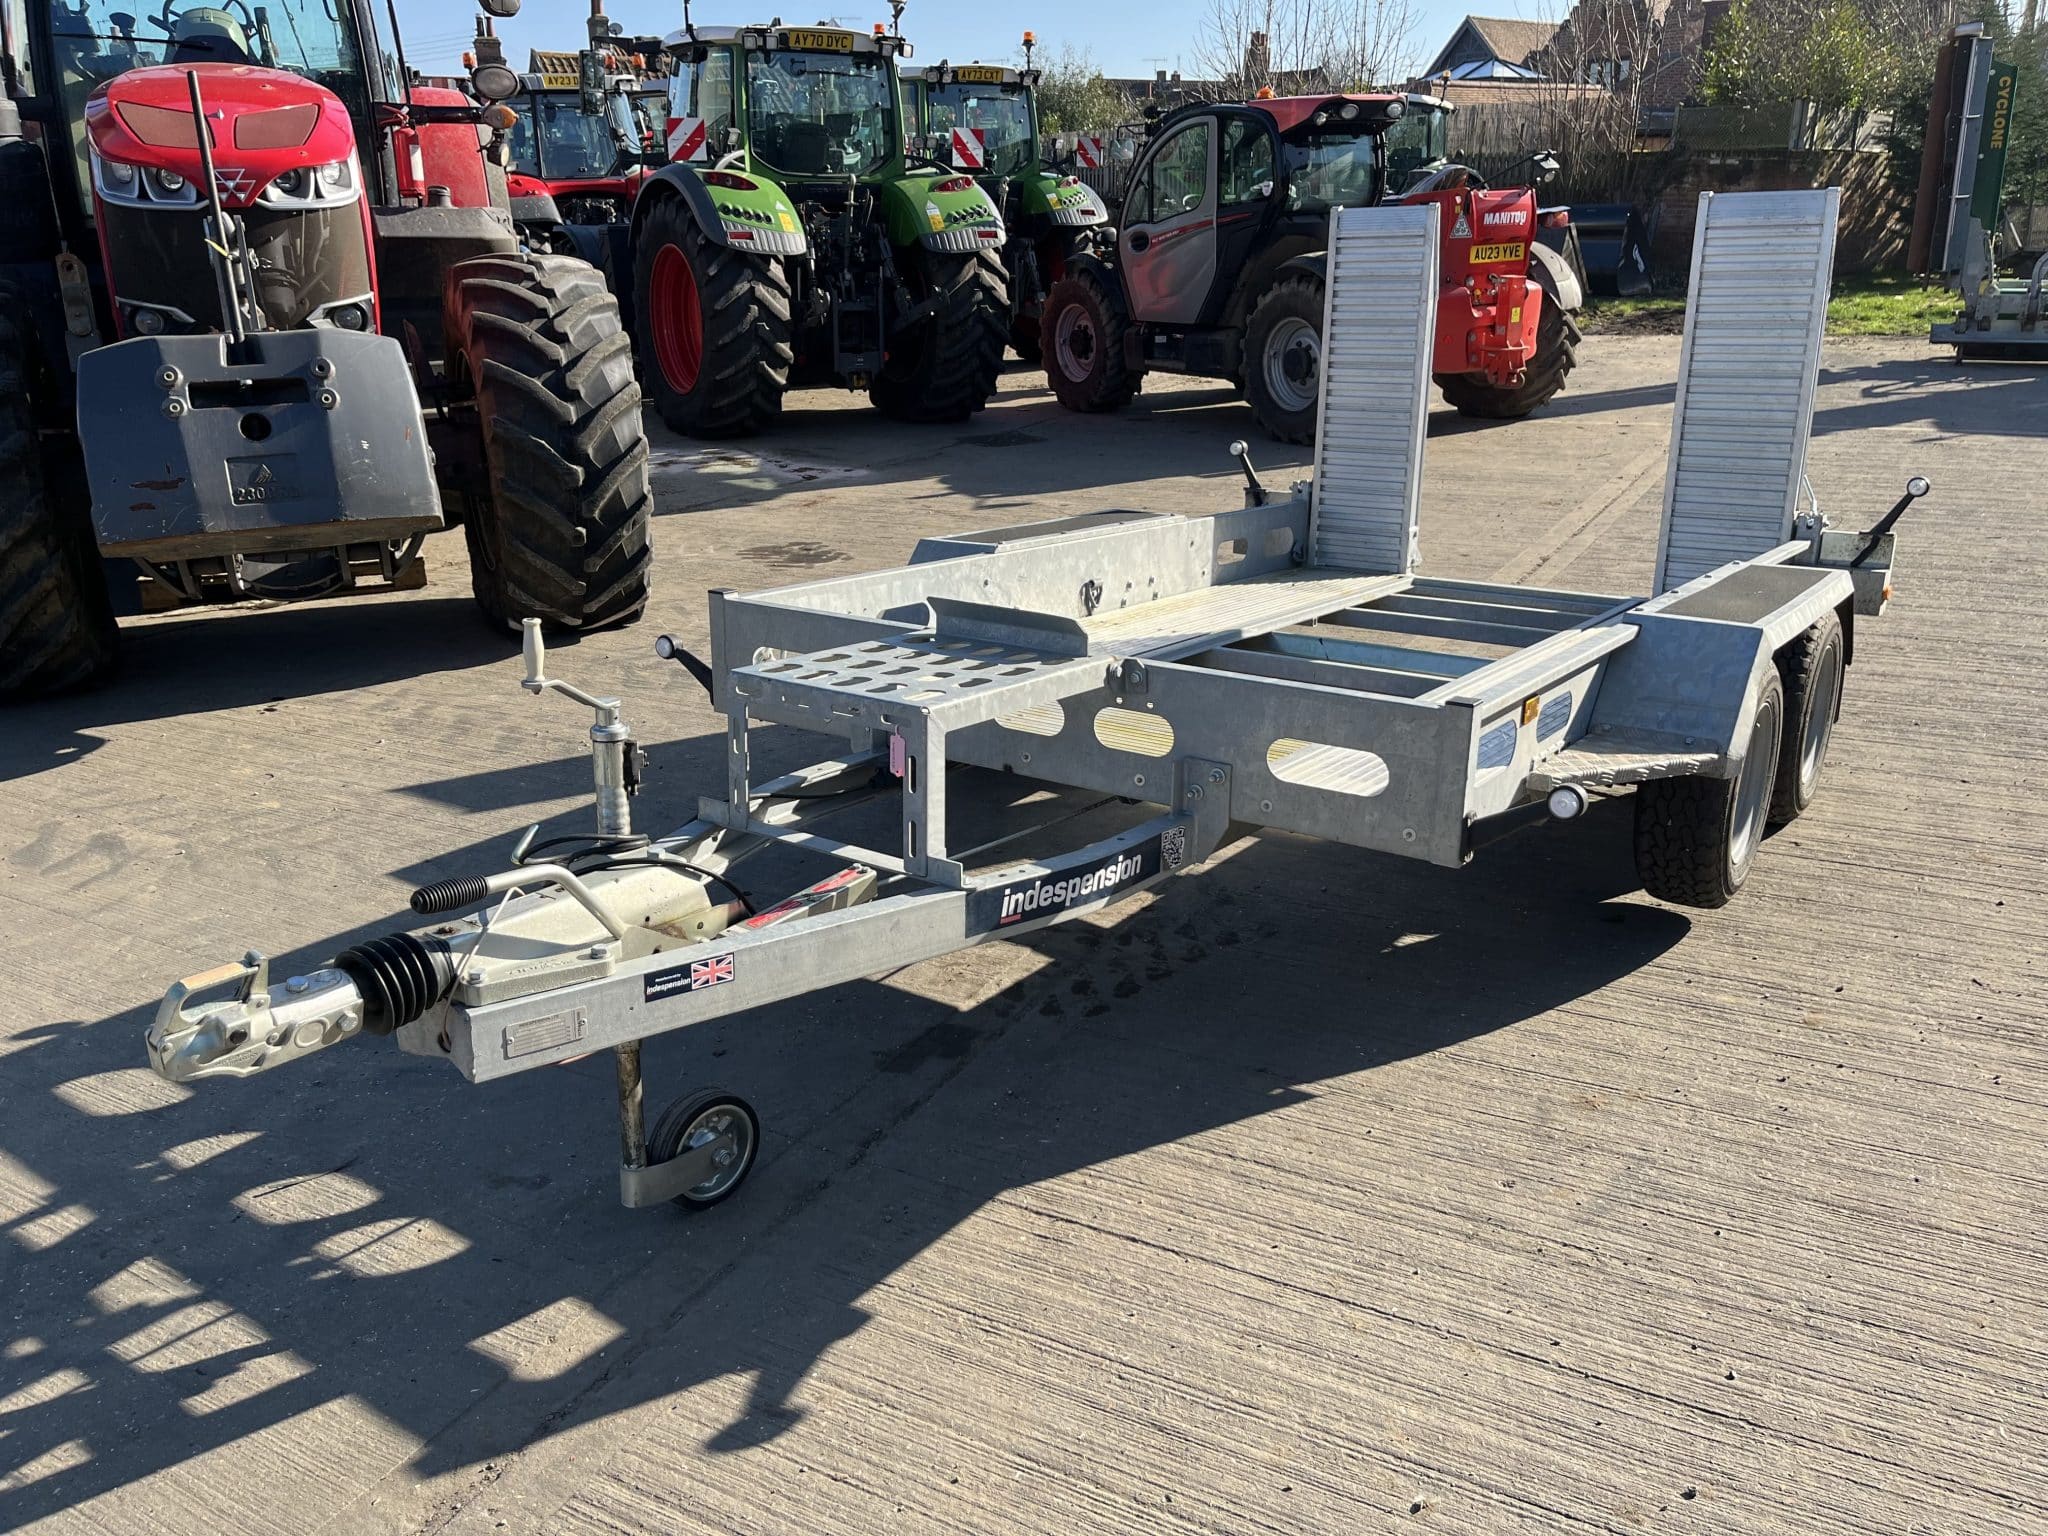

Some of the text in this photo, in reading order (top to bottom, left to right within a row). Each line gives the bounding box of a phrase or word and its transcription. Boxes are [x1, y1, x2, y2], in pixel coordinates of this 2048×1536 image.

[794, 33, 849, 48] AY70 DYC
[548, 75, 571, 86] AY23
[960, 69, 982, 80] AY73
[1990, 76, 2012, 149] CYCLONE
[1483, 211, 1527, 225] MANITOU
[1474, 245, 1521, 261] AU23 YVE
[1000, 853, 1142, 918] indespension
[646, 977, 692, 995] indespension
